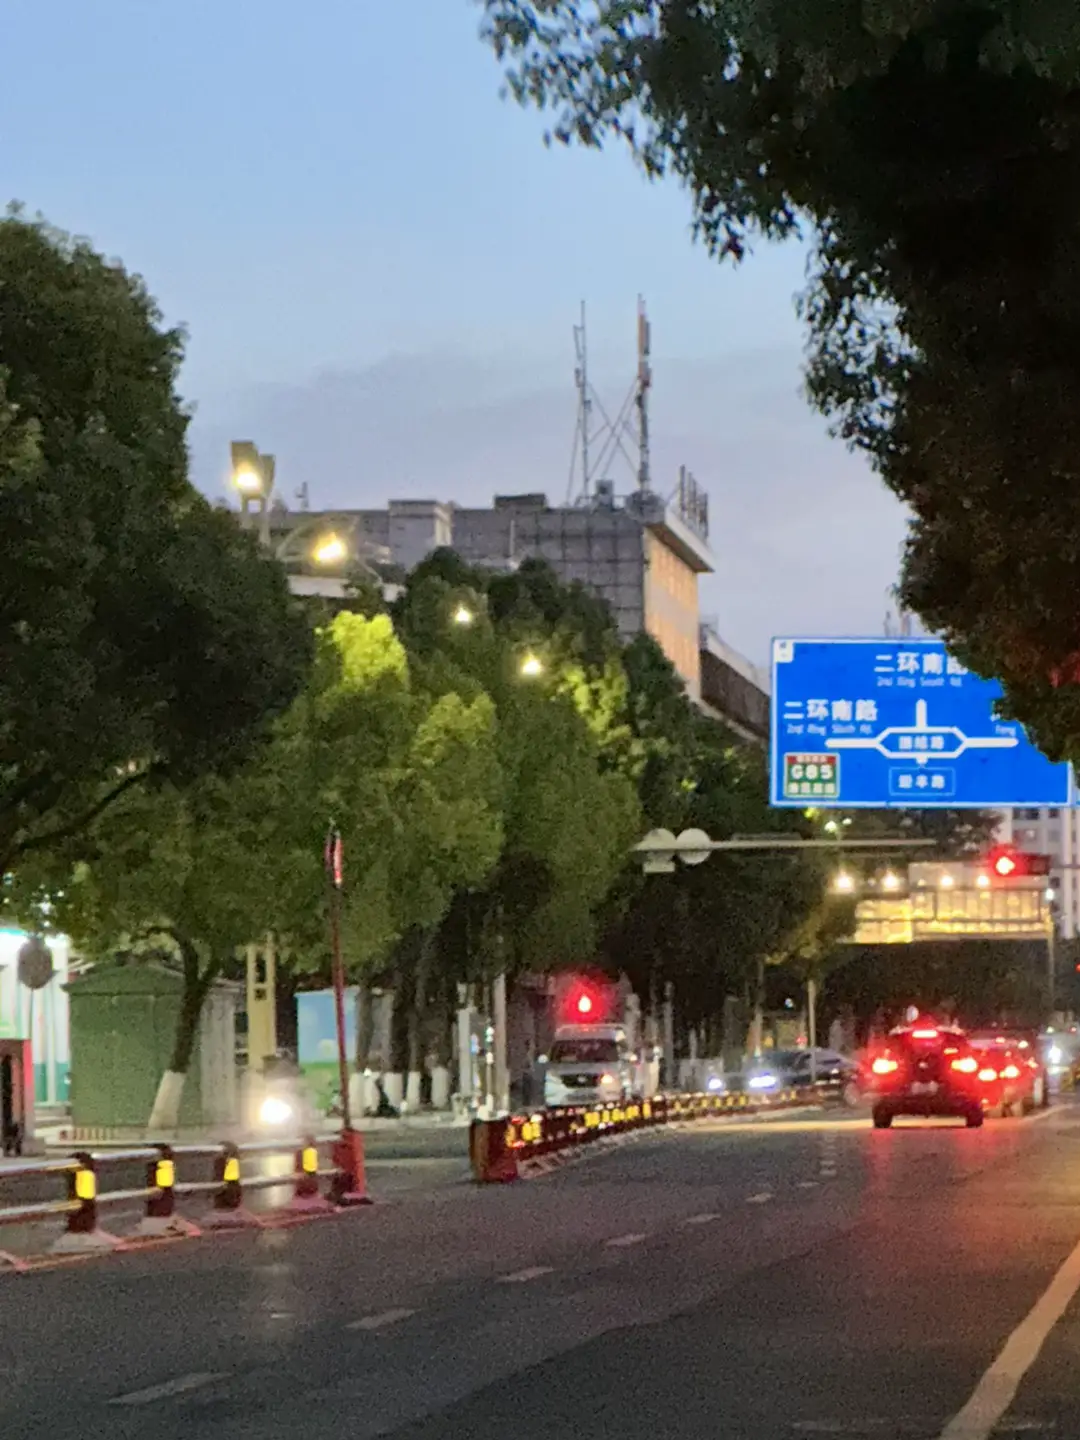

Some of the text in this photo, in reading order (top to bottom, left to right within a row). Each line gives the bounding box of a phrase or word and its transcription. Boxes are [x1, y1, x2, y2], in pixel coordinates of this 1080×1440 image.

[874, 652, 969, 675] 二环南路
[783, 699, 878, 721] 二环南路
